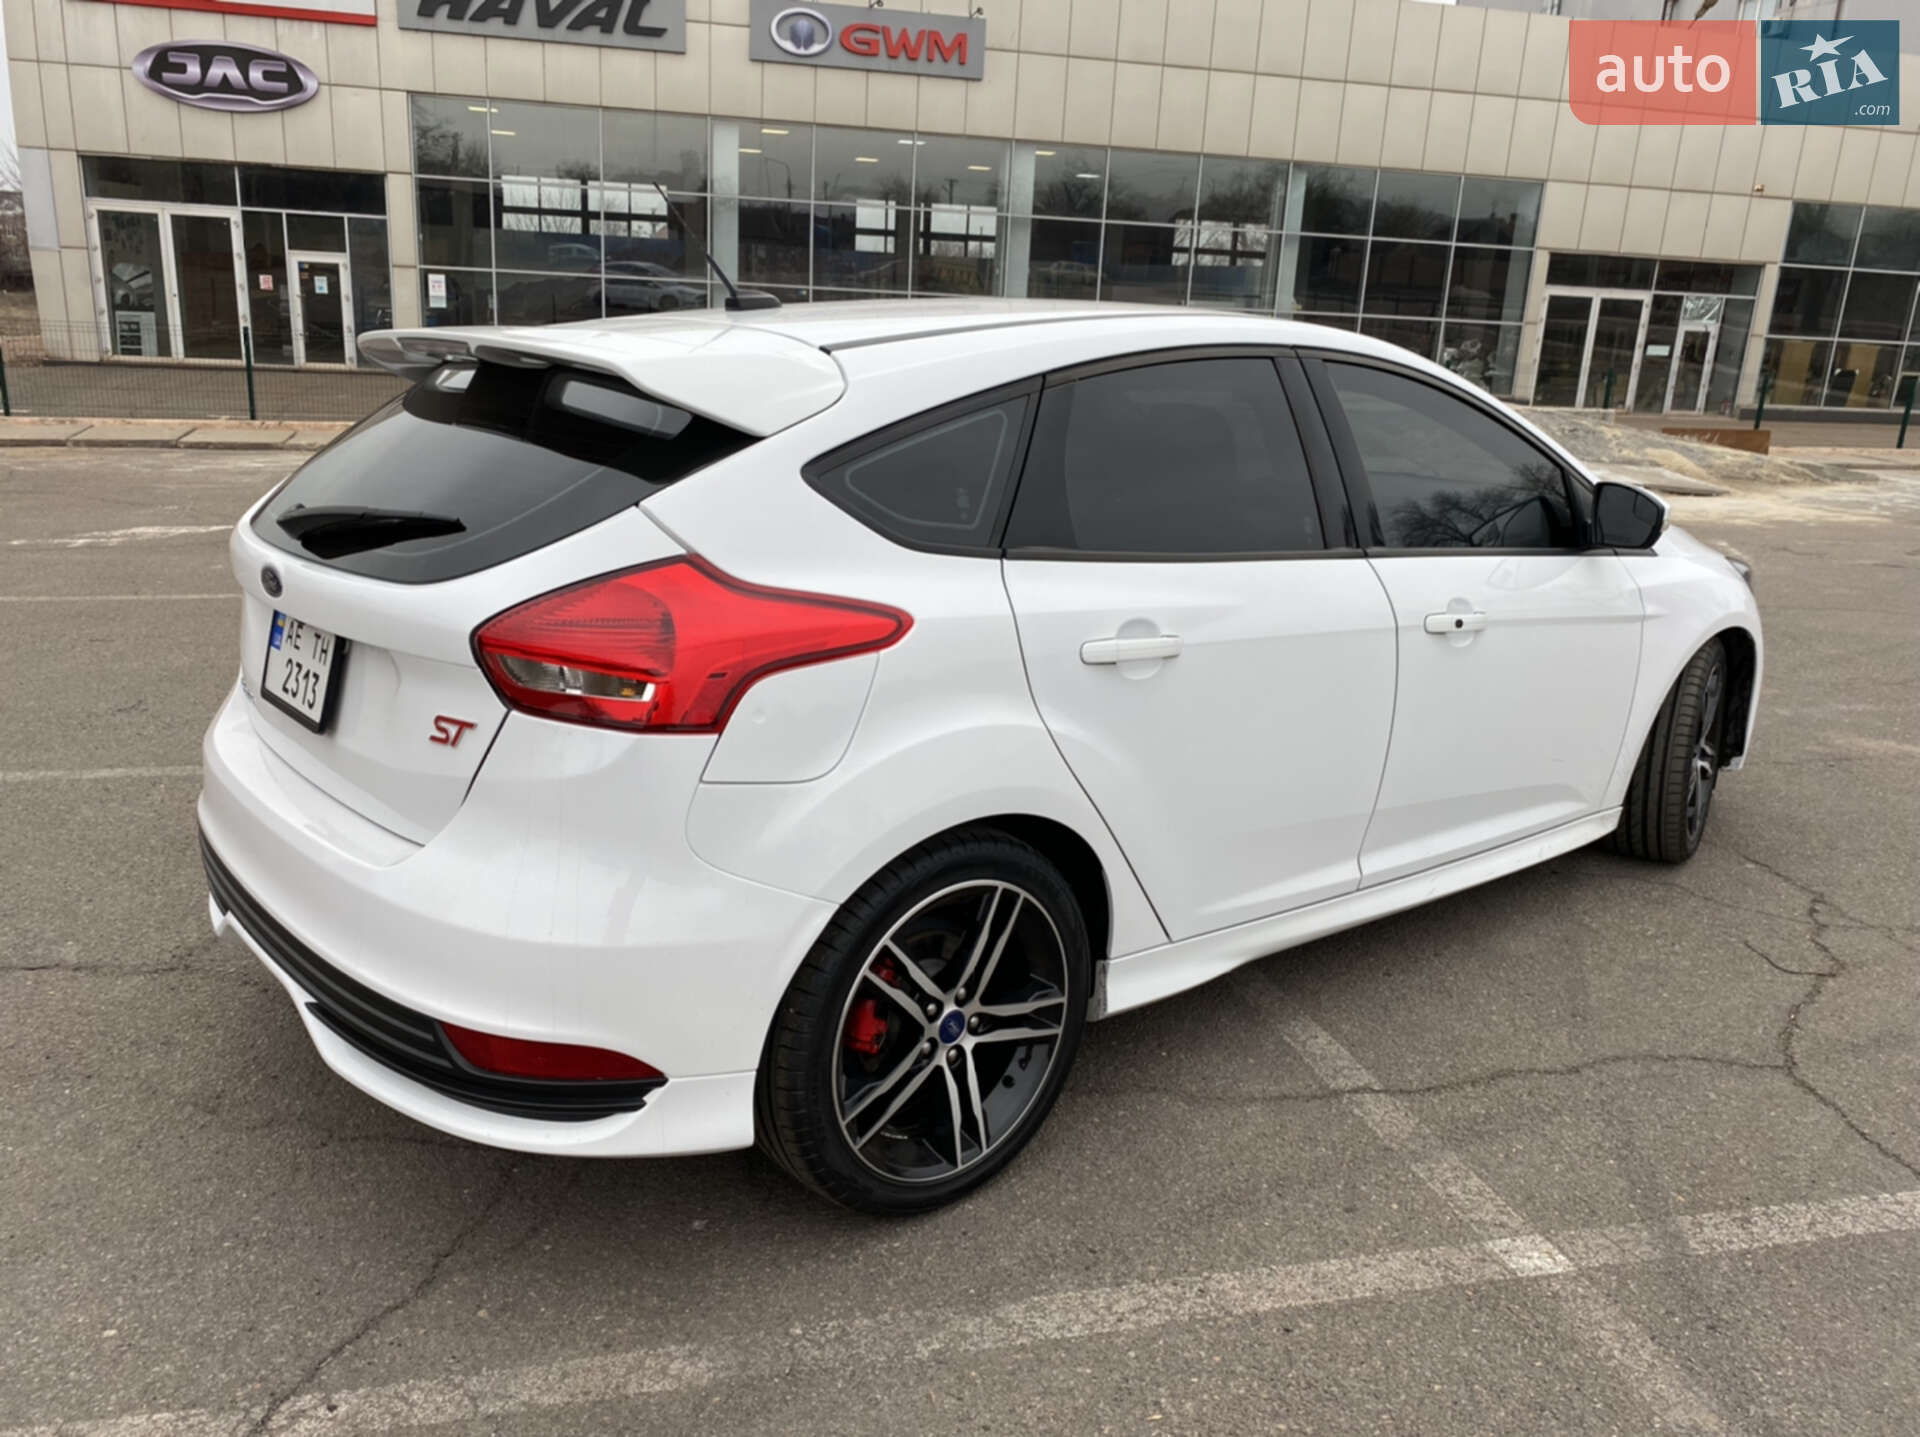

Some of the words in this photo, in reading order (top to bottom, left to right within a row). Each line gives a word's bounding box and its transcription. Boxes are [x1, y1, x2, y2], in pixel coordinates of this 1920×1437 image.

[839, 23, 968, 65] GWM
[161, 51, 290, 93] JAC
[284, 620, 305, 651] AE
[312, 632, 331, 667] TH
[281, 657, 321, 710] 2313
[428, 714, 478, 748] ST
